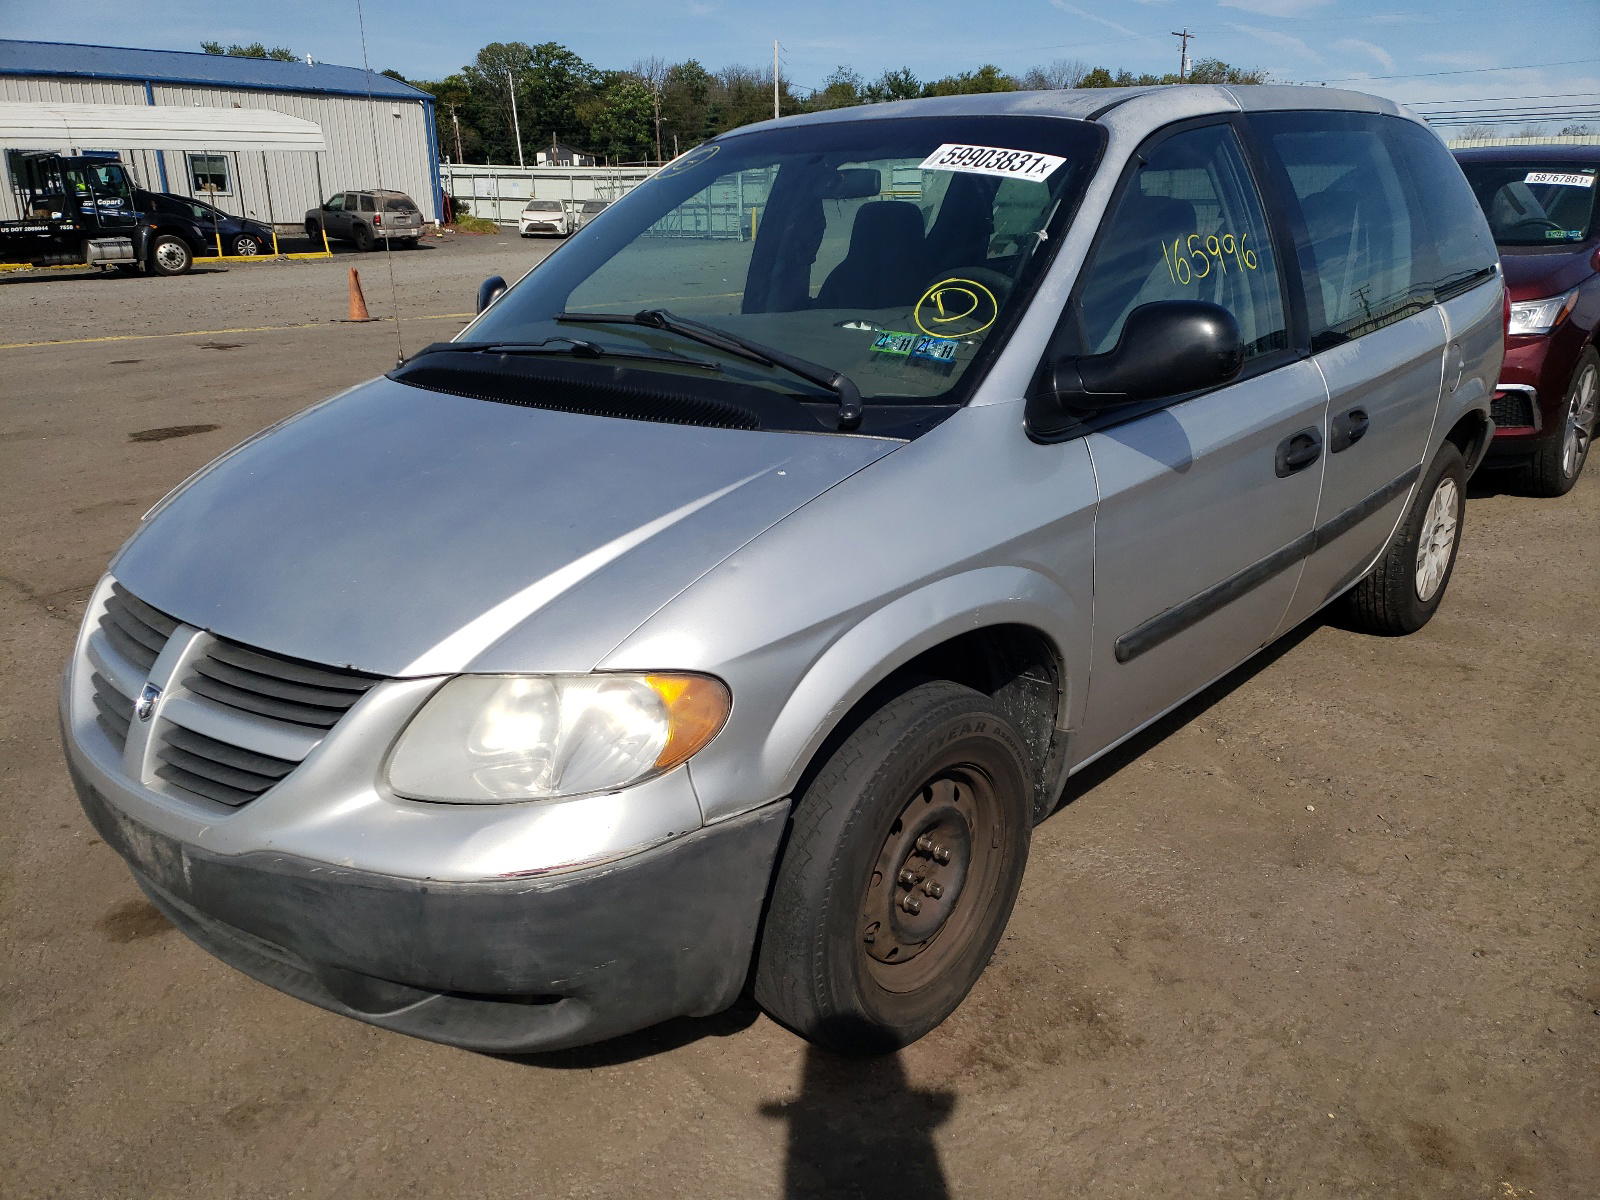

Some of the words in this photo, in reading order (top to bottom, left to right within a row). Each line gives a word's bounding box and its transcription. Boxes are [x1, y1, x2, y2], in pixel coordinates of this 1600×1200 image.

[97, 198, 121, 207] Copart
[1161, 233, 1258, 285] 165996
[930, 287, 978, 322] D
[875, 333, 890, 347] 21
[898, 337, 912, 352] 11
[915, 337, 932, 353] 21
[940, 344, 954, 359] 11
